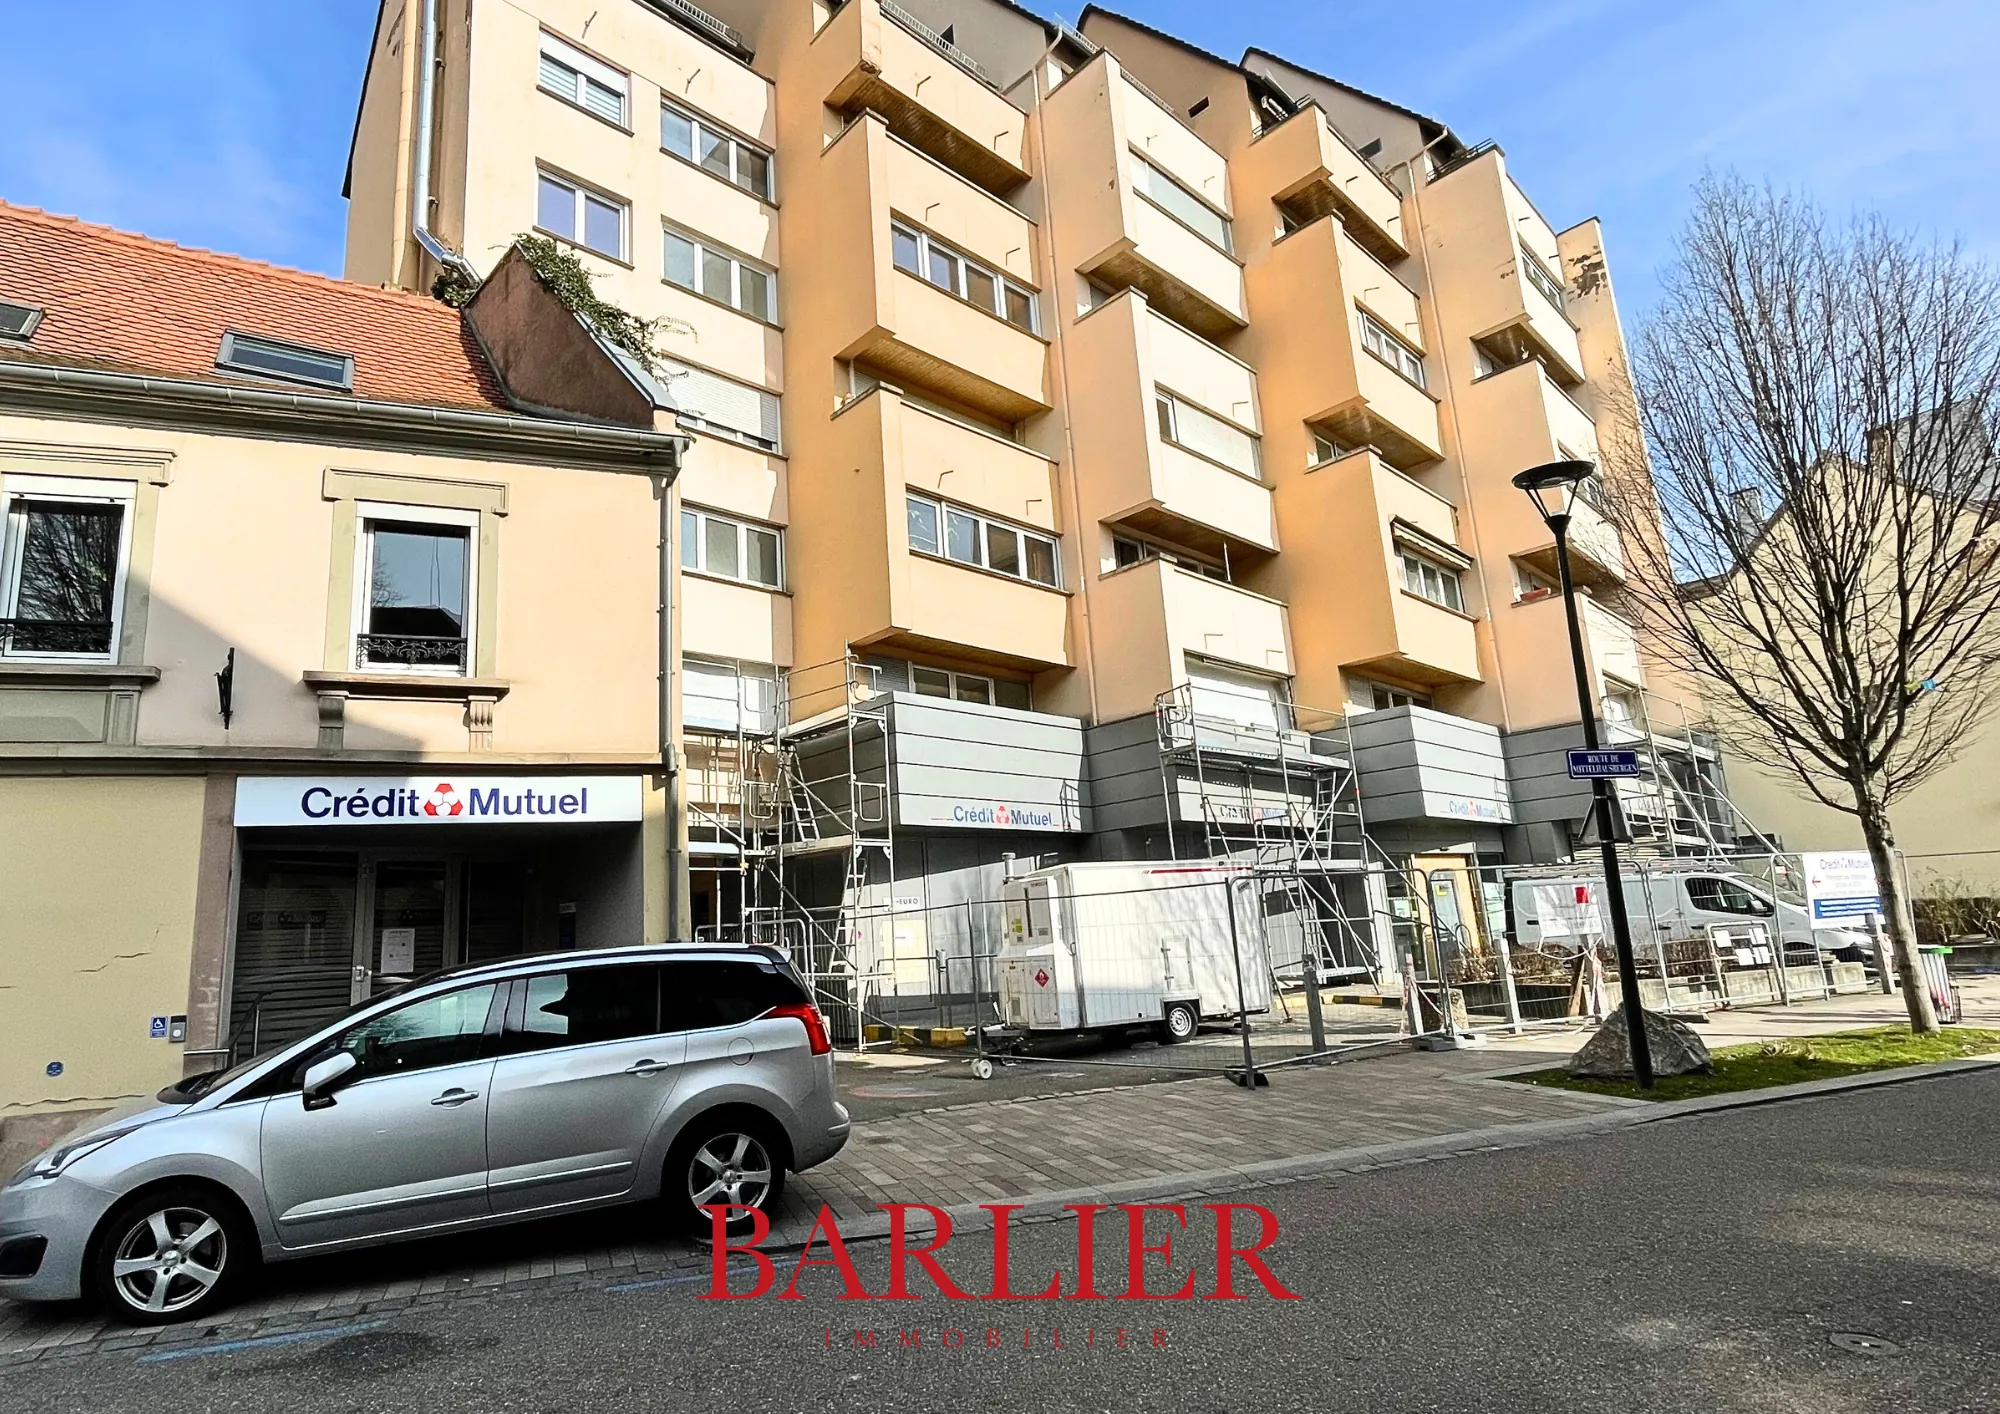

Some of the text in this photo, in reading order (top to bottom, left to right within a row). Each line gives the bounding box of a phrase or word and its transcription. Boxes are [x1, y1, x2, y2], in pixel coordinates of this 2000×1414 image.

[1610, 754, 1620, 763] DE
[301, 786, 587, 819] Crédit Mutuel
[953, 805, 1052, 825] Crédit Mutuel
